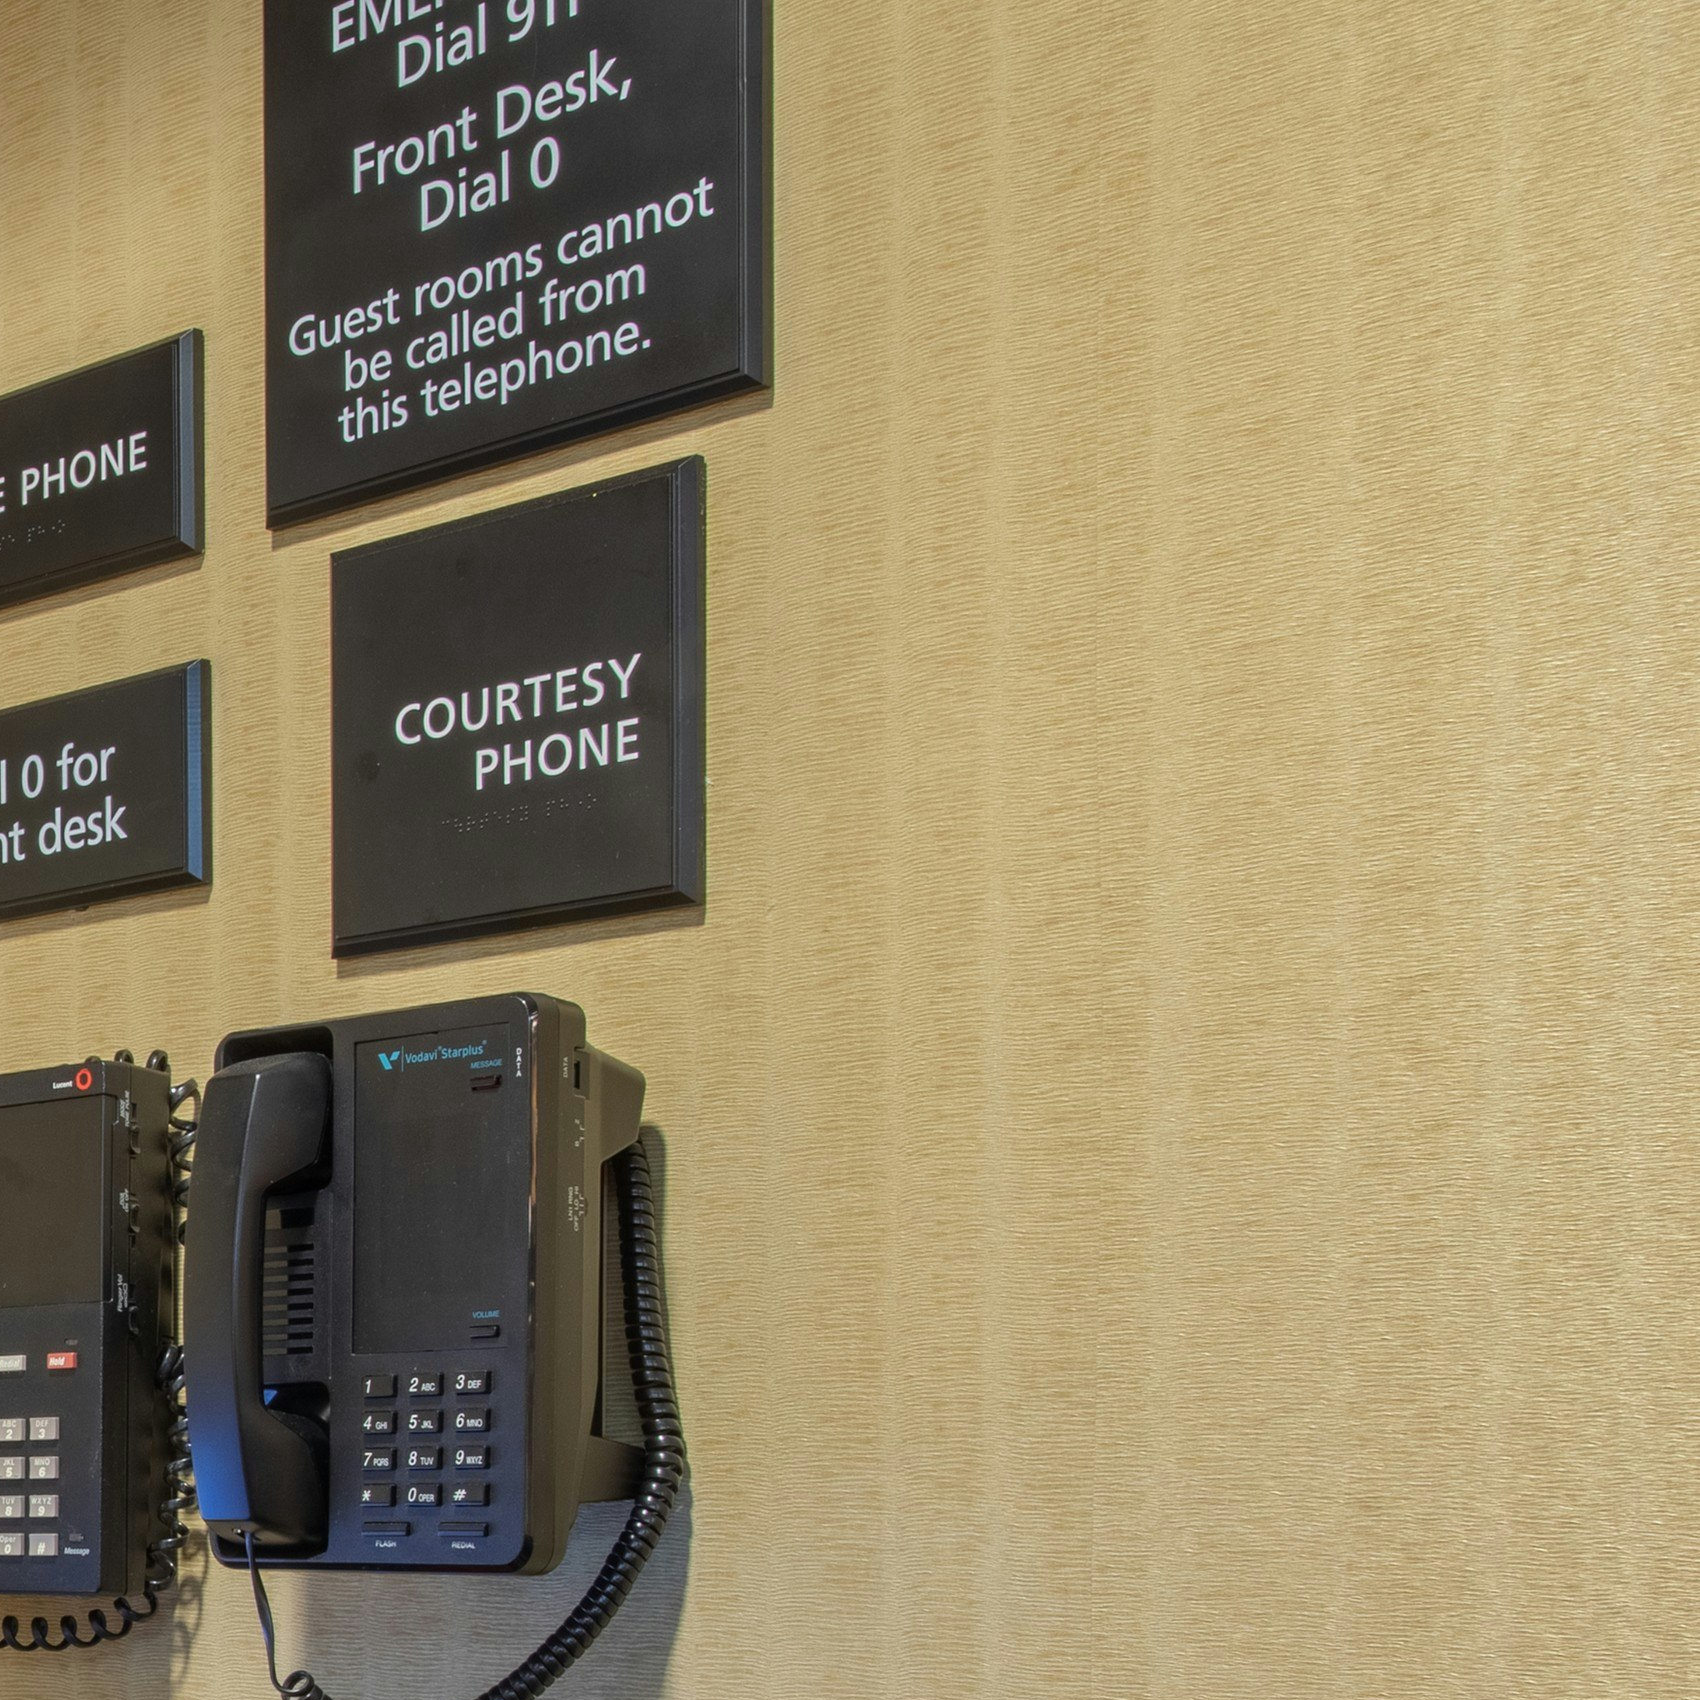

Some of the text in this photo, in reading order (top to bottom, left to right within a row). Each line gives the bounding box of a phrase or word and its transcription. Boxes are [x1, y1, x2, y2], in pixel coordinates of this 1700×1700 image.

[398, 2, 487, 88] Dial
[353, 49, 632, 194] Front Desk,
[420, 136, 561, 231] Dial 0
[288, 176, 715, 357] Guest rooms cannot
[344, 263, 647, 391] be called from
[338, 320, 652, 443] this telephone.
[21, 431, 147, 506] PHONE
[394, 653, 641, 745] COURTESY
[475, 717, 640, 790] PHONE
[21, 754, 45, 799] 0
[56, 742, 116, 790] for
[38, 795, 128, 855] desk
[470, 1058, 504, 1069] MESSAGE
[52, 1081, 73, 1089] Lucent
[472, 1310, 500, 1318] VOLUME
[0, 1359, 20, 1369] Redial
[49, 1356, 65, 1366] Hold
[365, 1379, 371, 1393] 1
[409, 1377, 436, 1392] 2 ABC
[455, 1374, 482, 1389] 3 DEF
[2, 1420, 17, 1428] ABC
[35, 1419, 49, 1427] DEF
[363, 1416, 388, 1430] 4 GHI
[409, 1415, 434, 1429] 5 JKL
[455, 1413, 483, 1428] 6 MNO
[5, 1429, 13, 1440] 2
[38, 1428, 46, 1439] 3
[34, 1458, 50, 1466] MNO
[363, 1452, 373, 1466] 7
[408, 1451, 434, 1465] 8 TUV
[455, 1450, 483, 1465] 9 WXYZ
[5, 1467, 13, 1477] 5
[38, 1467, 46, 1477] 6
[408, 1487, 435, 1502] 0 OPER
[1, 1497, 15, 1505] TUV
[31, 1497, 52, 1505] WXYZ
[5, 1506, 12, 1516] 8
[37, 1506, 45, 1516] 9
[0, 1535, 16, 1544] Oper
[375, 1540, 397, 1548] FLASH
[451, 1541, 475, 1549] REDIAL
[4, 1544, 12, 1554] 0
[64, 1547, 90, 1556] Message
